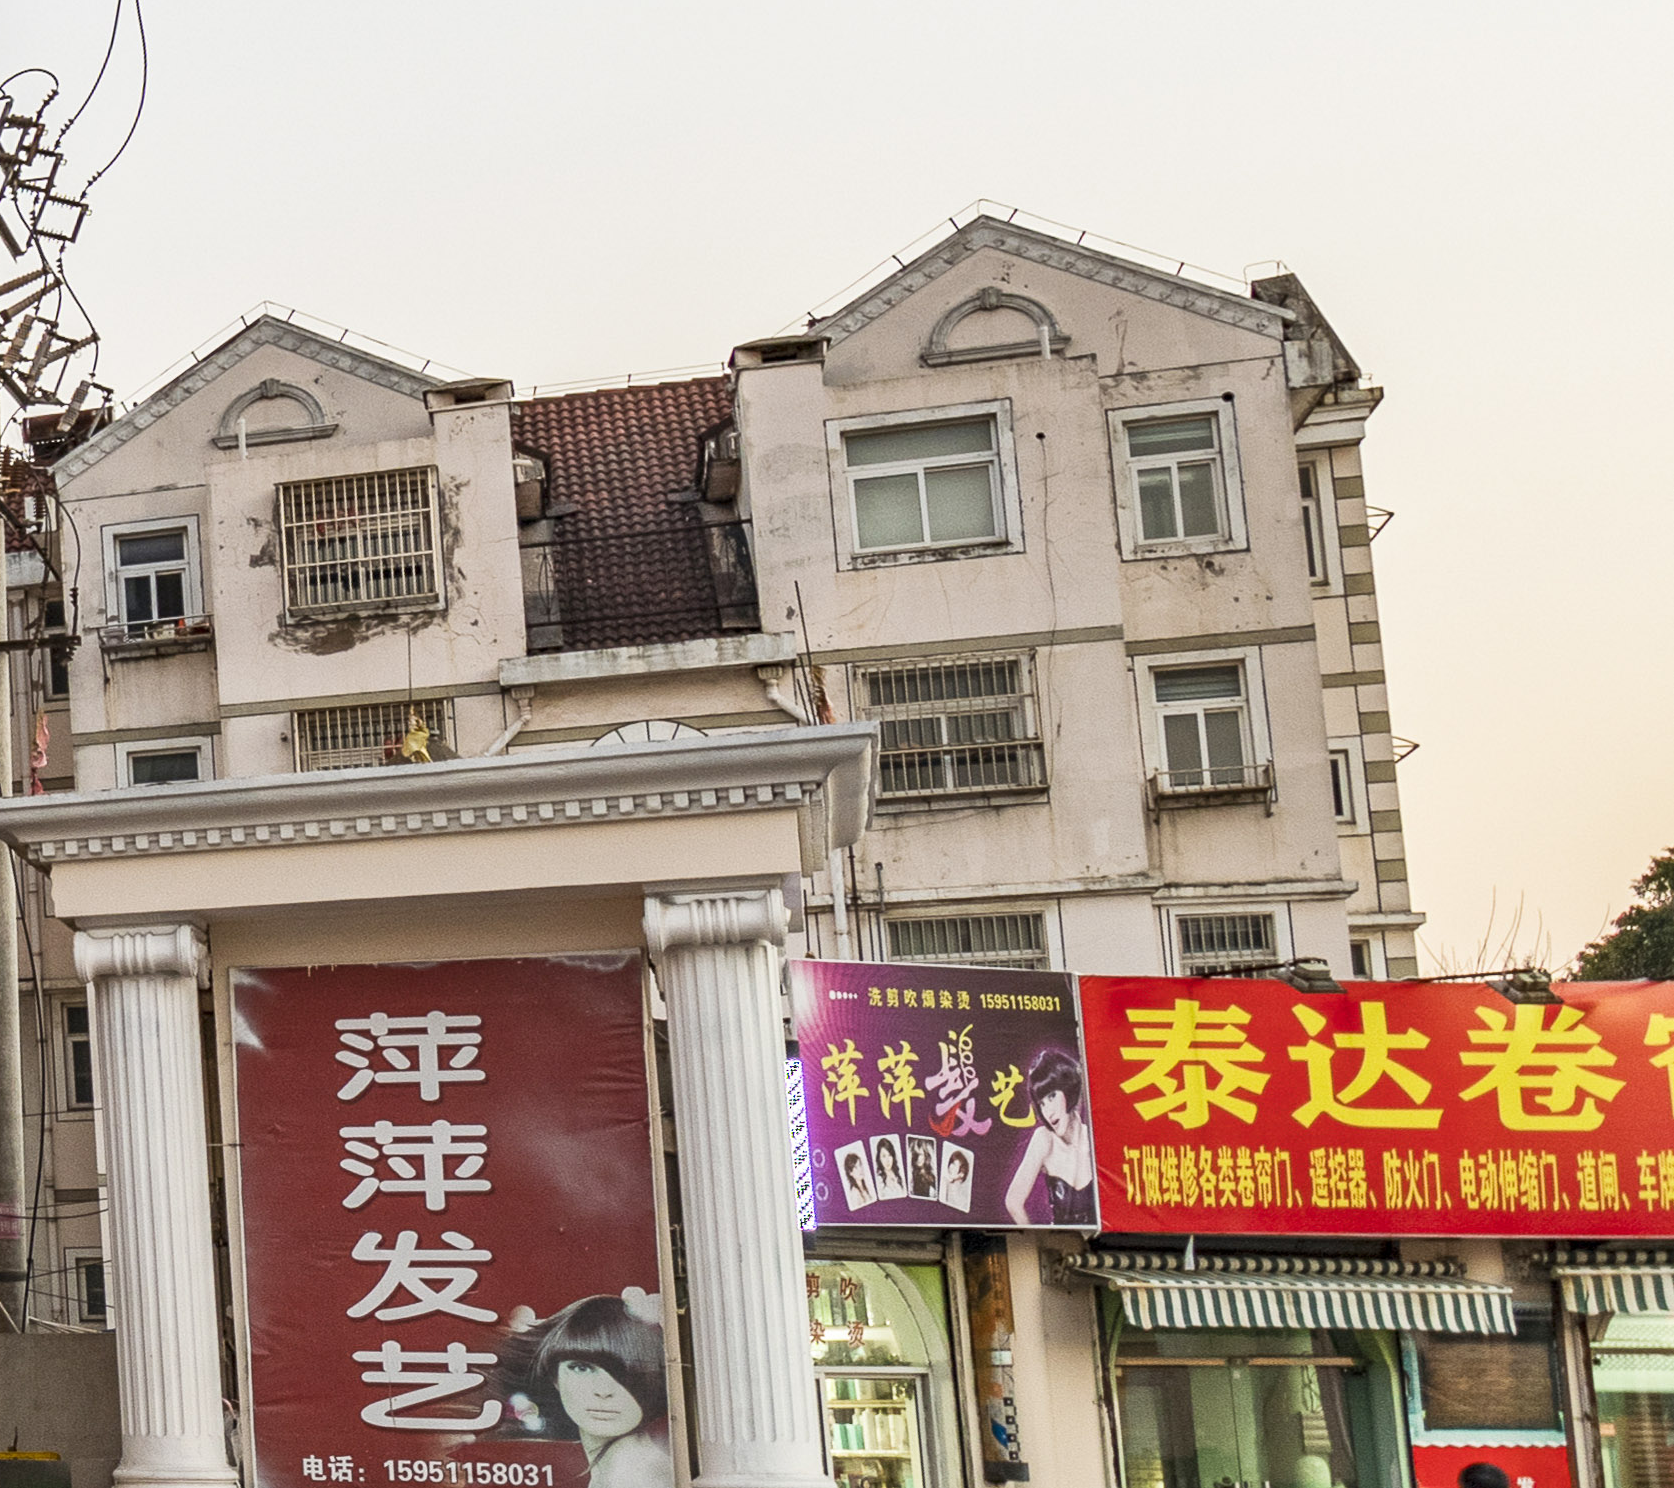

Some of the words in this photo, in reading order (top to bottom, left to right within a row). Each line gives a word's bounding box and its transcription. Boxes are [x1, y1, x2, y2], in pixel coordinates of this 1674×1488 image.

[980, 992, 1061, 1012] 15951158031
[334, 1009, 502, 1433] 萍萍发艺
[383, 1459, 554, 1487] 15951158031
